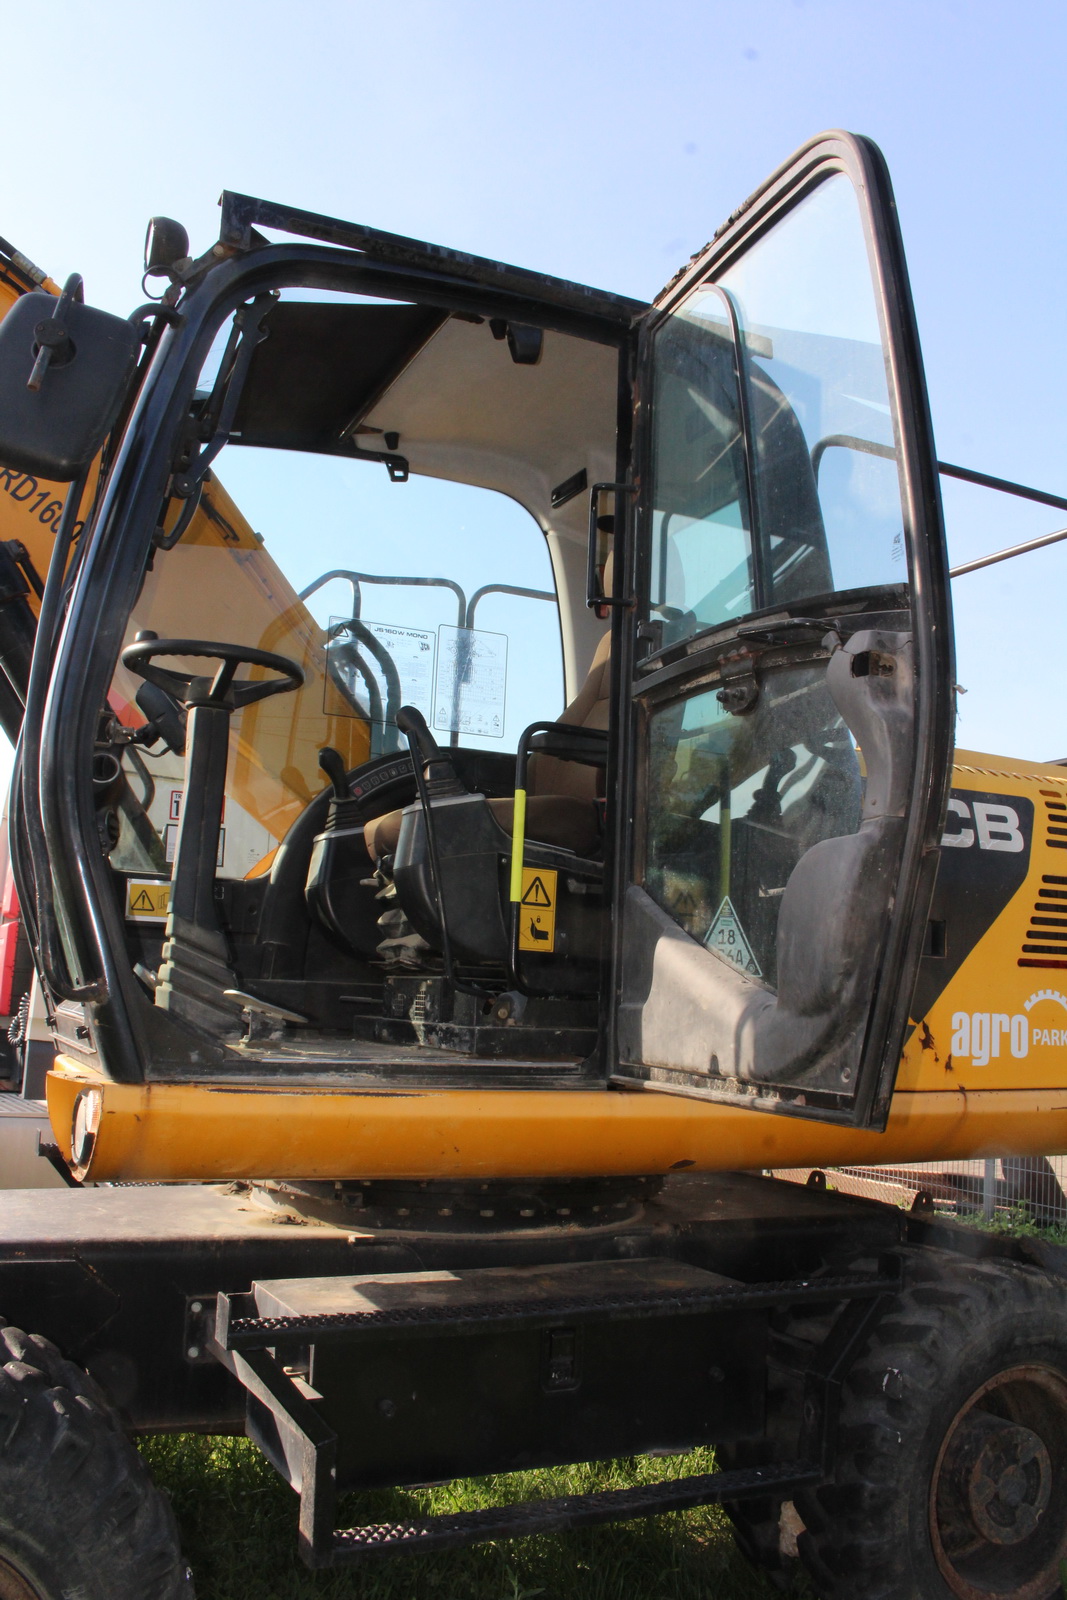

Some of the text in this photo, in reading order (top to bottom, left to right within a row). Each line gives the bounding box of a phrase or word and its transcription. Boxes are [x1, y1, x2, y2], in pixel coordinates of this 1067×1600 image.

[406, 632, 429, 640] MONO
[717, 928, 736, 945] 18
[951, 1011, 1029, 1067] agro
